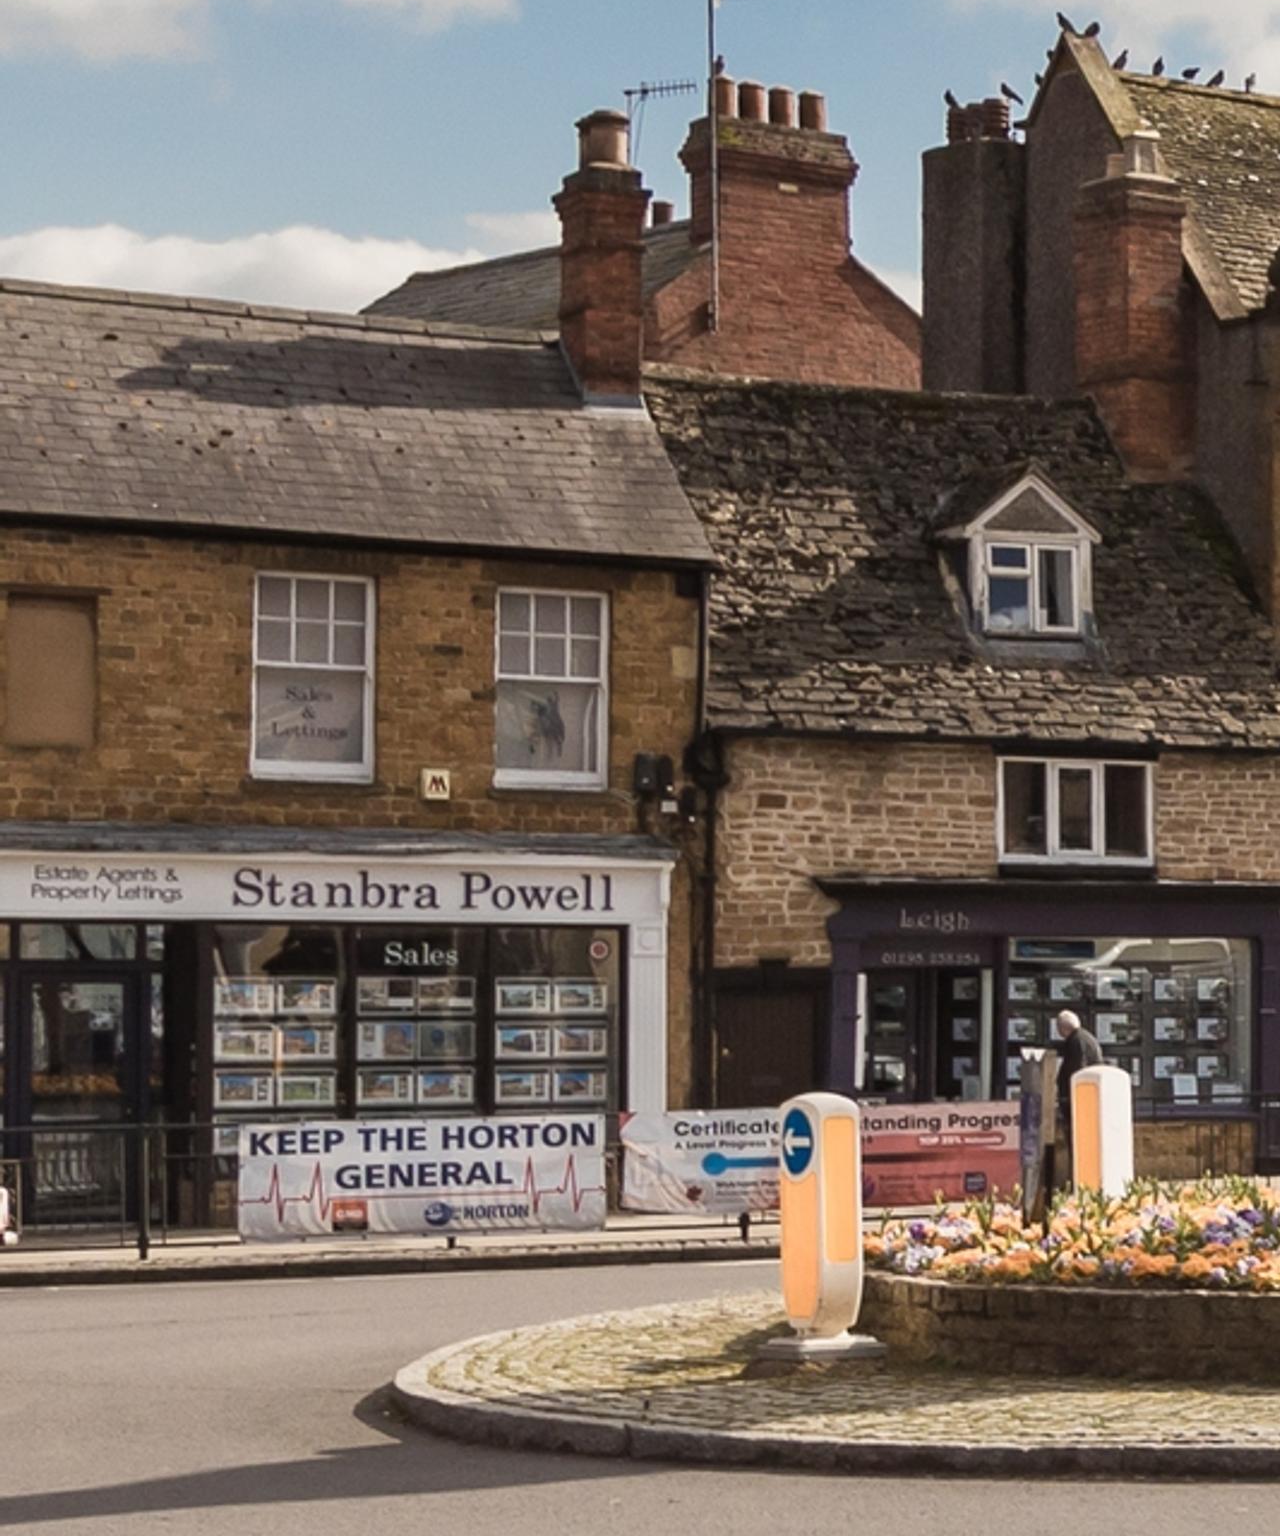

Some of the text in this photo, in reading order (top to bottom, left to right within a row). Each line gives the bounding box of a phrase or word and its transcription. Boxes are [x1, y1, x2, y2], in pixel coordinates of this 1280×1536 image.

[272, 722, 348, 741] Lettings
[33, 865, 179, 883] Estate Agents &
[30, 884, 183, 904] Property Lettings
[232, 868, 614, 912] Stanbra Powell
[901, 908, 970, 932] Leigh
[384, 941, 459, 966] Sales
[861, 1114, 1020, 1132] tanding Progres
[250, 1122, 596, 1156] KEEP THE HORTON
[675, 1141, 682, 1149] A
[334, 1161, 514, 1190] GENERAL
[464, 1204, 529, 1220] HORTON
